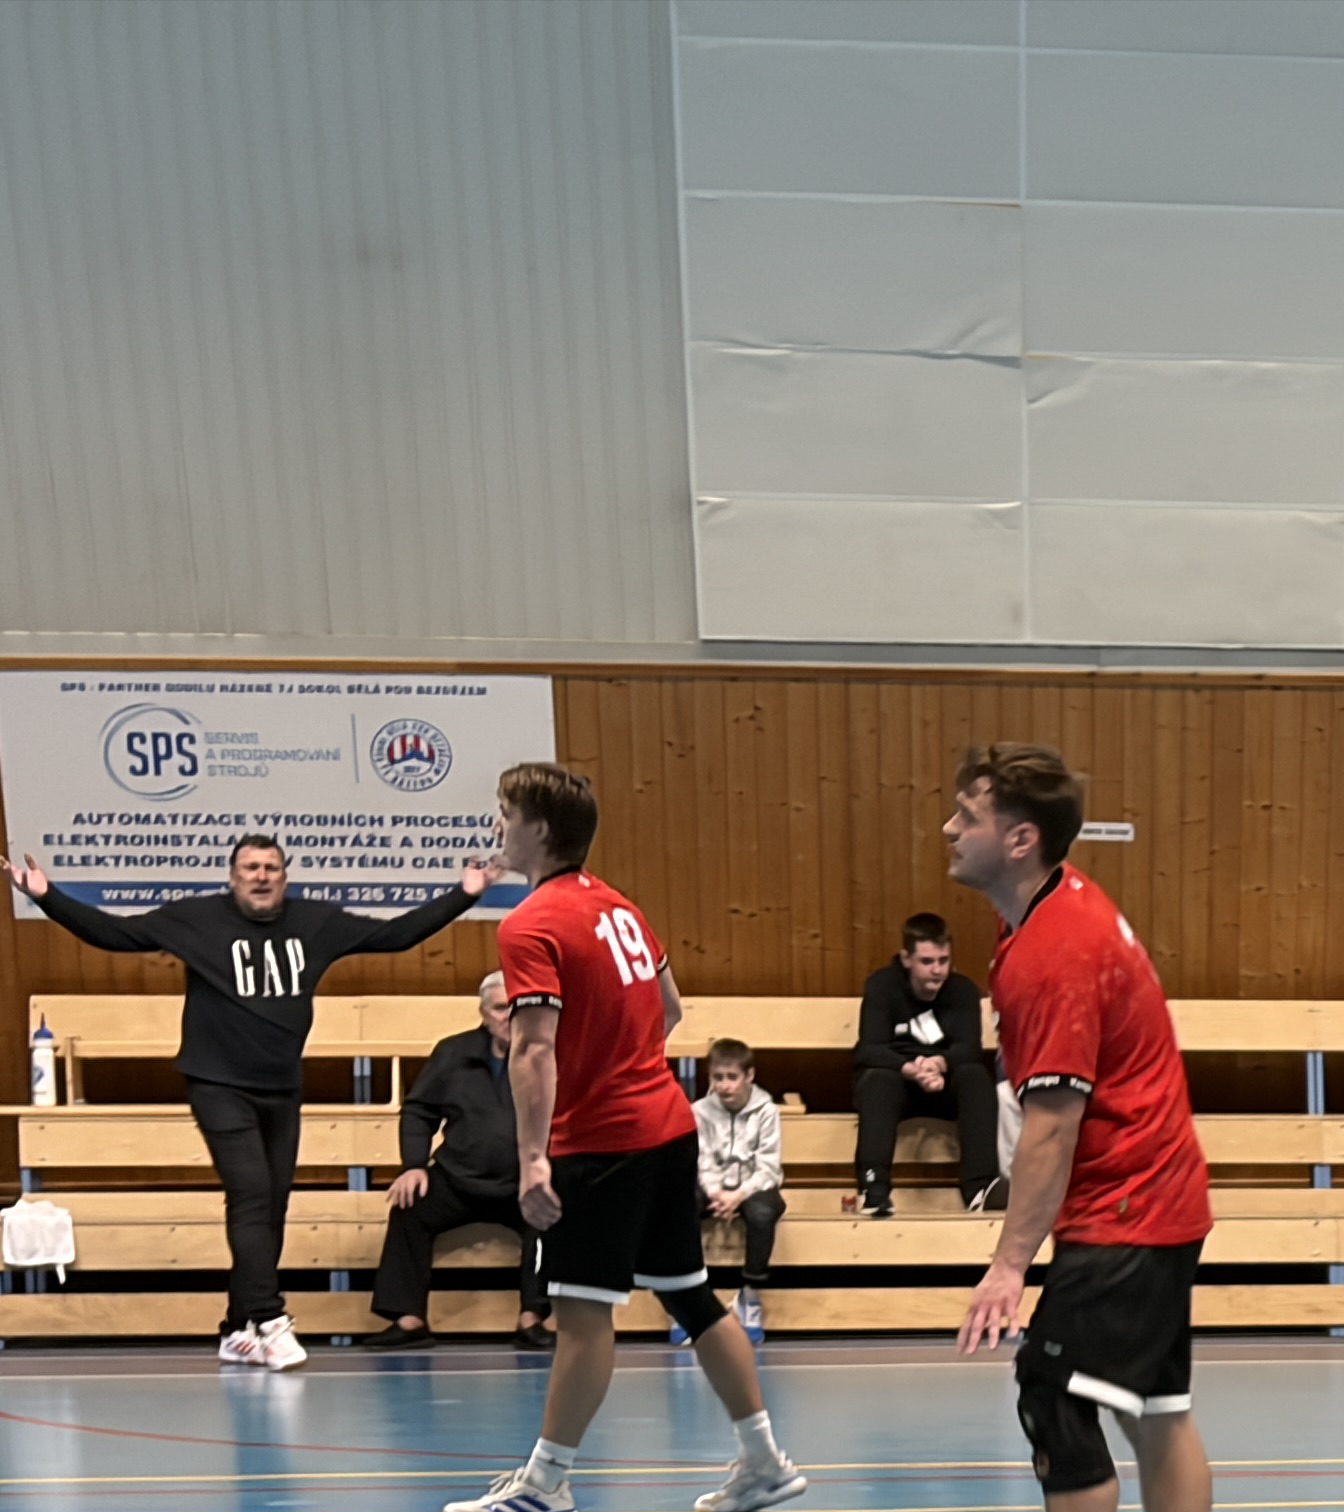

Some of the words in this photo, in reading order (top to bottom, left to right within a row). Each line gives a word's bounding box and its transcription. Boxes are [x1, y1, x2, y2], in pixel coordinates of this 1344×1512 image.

[126, 731, 199, 777] SPS
[204, 748, 217, 760] A
[72, 812, 247, 826] AUTOMATIZACE
[253, 812, 385, 828] VÝROBNÍCH
[286, 834, 392, 848] MONTÁŽE
[400, 835, 414, 849] A
[300, 854, 405, 869] SYSTÉMU
[411, 856, 455, 870] CAE
[594, 907, 656, 987] 19
[231, 938, 306, 998] GAP
